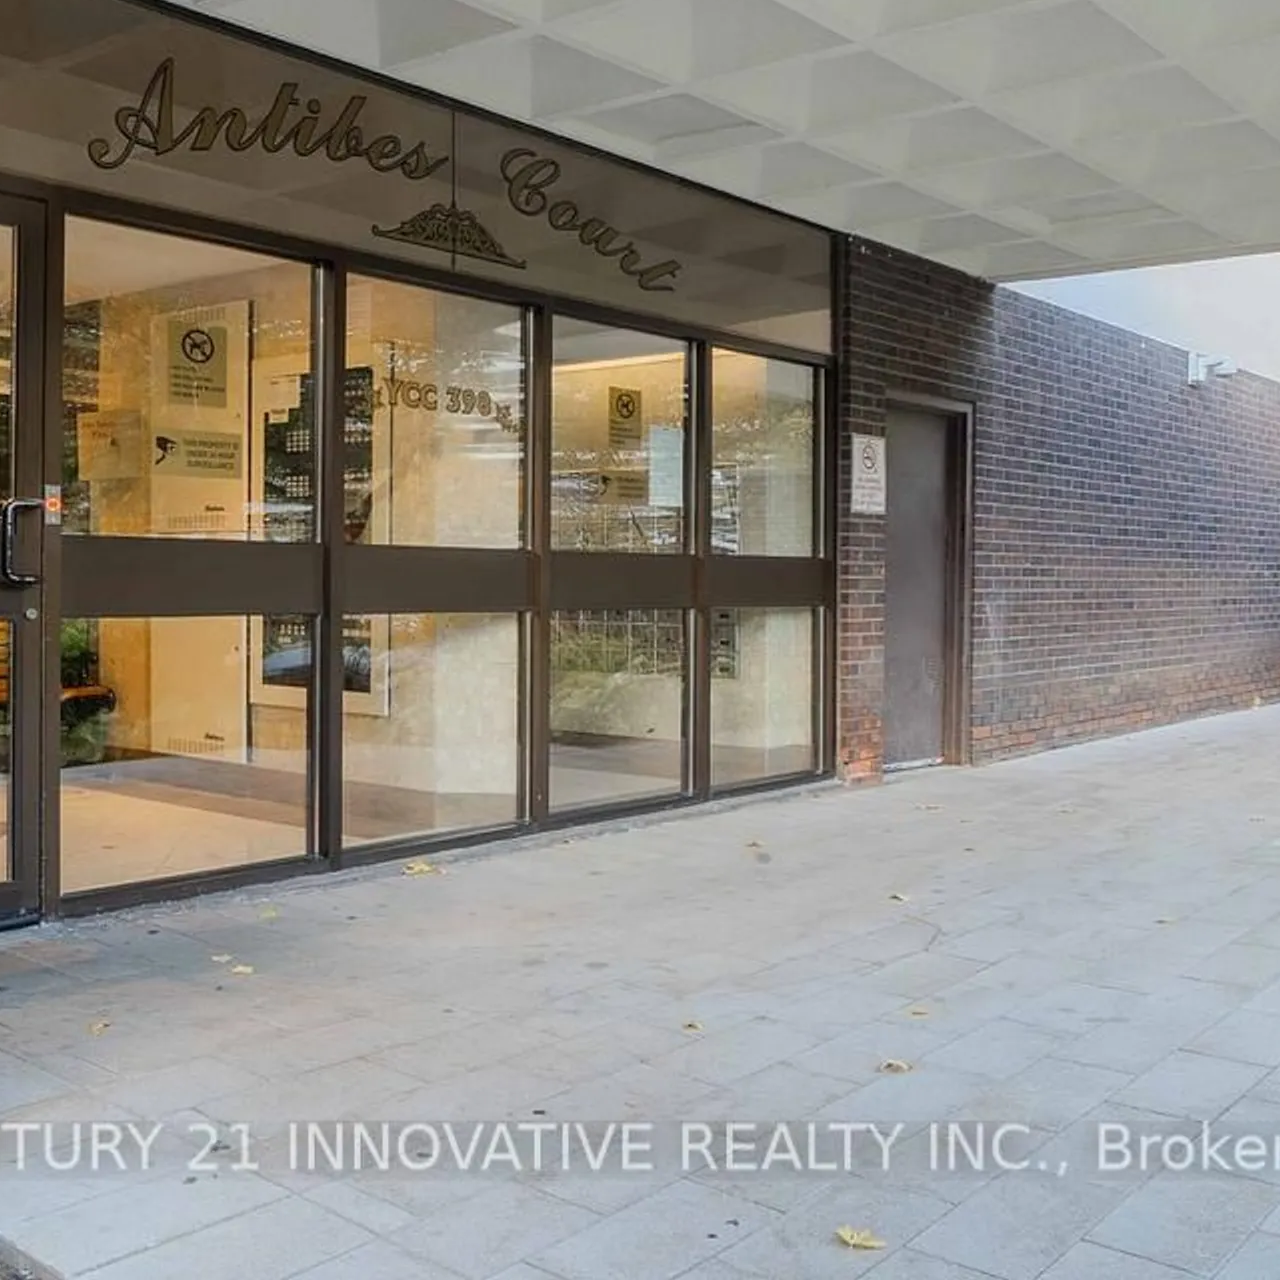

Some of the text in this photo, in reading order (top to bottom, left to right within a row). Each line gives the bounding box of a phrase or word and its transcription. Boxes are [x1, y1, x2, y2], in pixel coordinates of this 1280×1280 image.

[87, 56, 682, 291] Antibes Court
[384, 376, 492, 417] YCC 398
